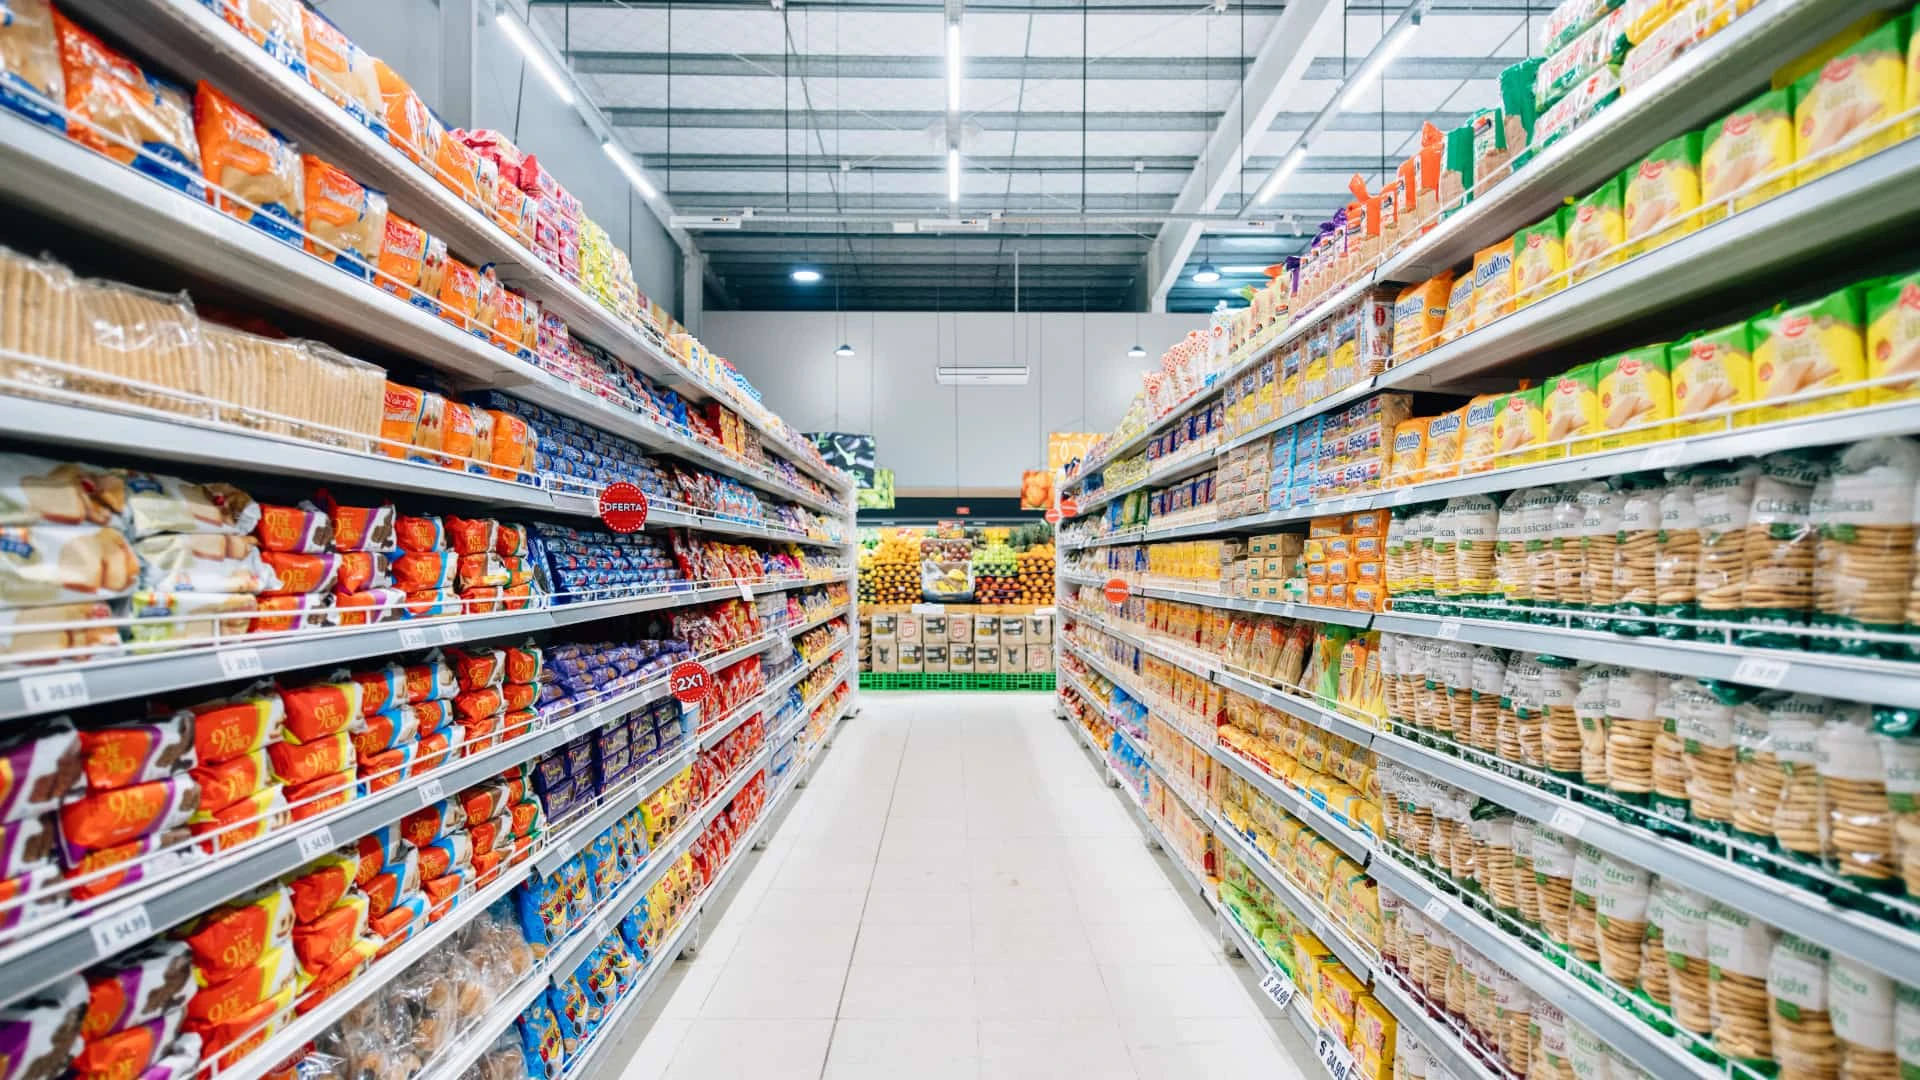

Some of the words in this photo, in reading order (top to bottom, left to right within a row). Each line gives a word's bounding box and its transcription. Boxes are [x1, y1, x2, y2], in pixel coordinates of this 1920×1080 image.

[605, 503, 642, 512] OFERTA
[676, 673, 703, 691] 2X1
[1269, 983, 1290, 1005] 34.99
[1327, 1050, 1346, 1080] 34.99
